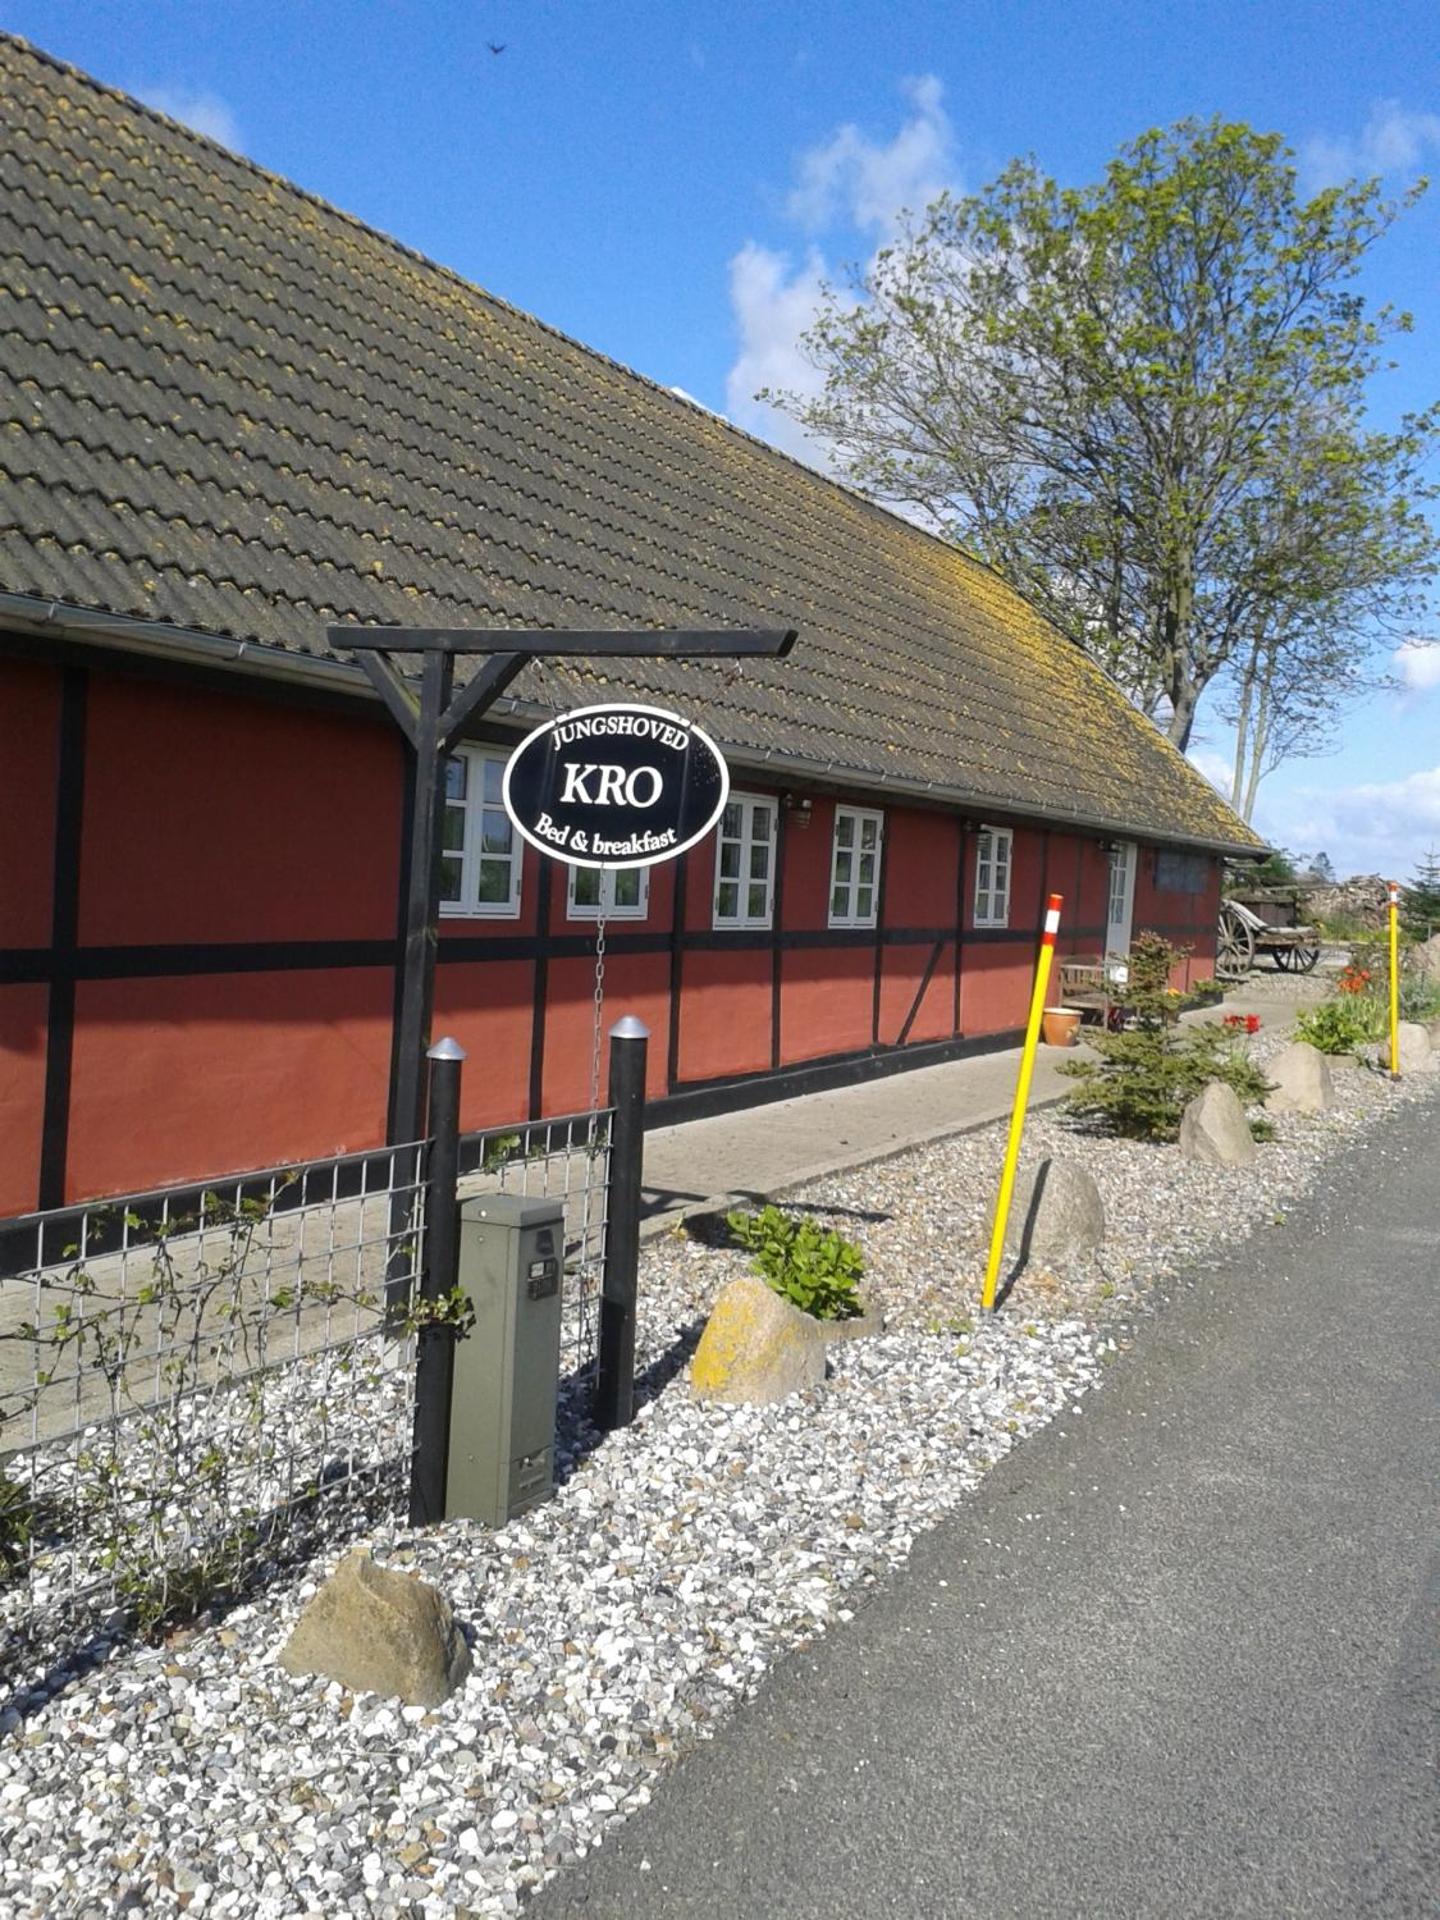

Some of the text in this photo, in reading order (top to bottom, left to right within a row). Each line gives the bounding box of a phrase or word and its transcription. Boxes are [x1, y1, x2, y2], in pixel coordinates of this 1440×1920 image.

[552, 716, 690, 751] JUNGSHOVED
[560, 763, 663, 808] KRO
[534, 812, 677, 855] Bed & breakfast
